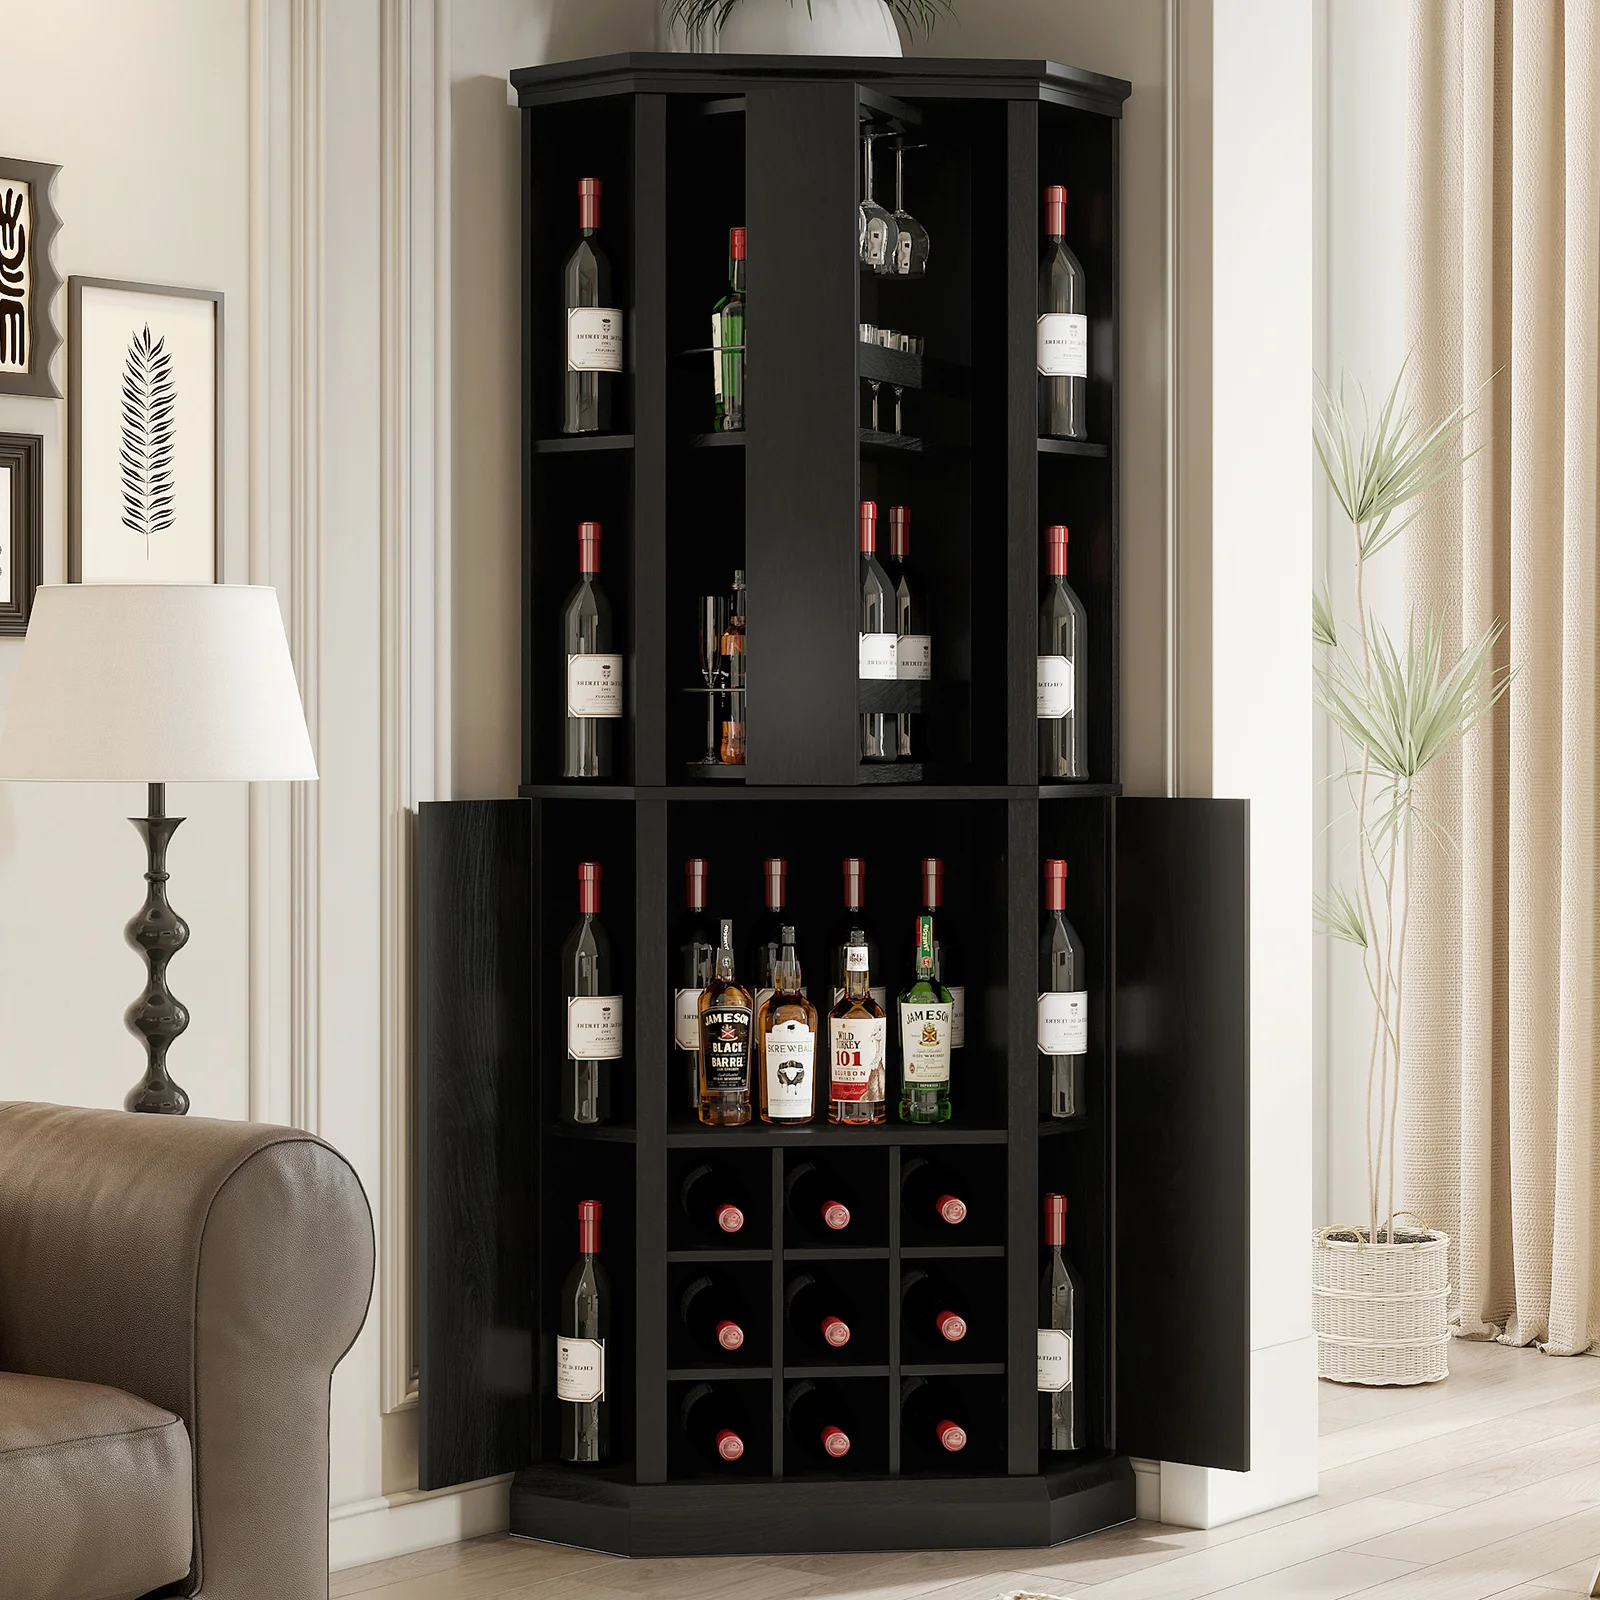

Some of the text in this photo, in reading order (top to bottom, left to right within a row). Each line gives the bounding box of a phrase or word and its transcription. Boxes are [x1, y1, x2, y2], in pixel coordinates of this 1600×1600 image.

[704, 1013, 749, 1026] JAMESON
[906, 1010, 949, 1025] JAMESON
[836, 1031, 854, 1041] WILD
[712, 1042, 743, 1053] BLACK
[711, 1056, 744, 1068] BARREL
[836, 1051, 862, 1067] 101
